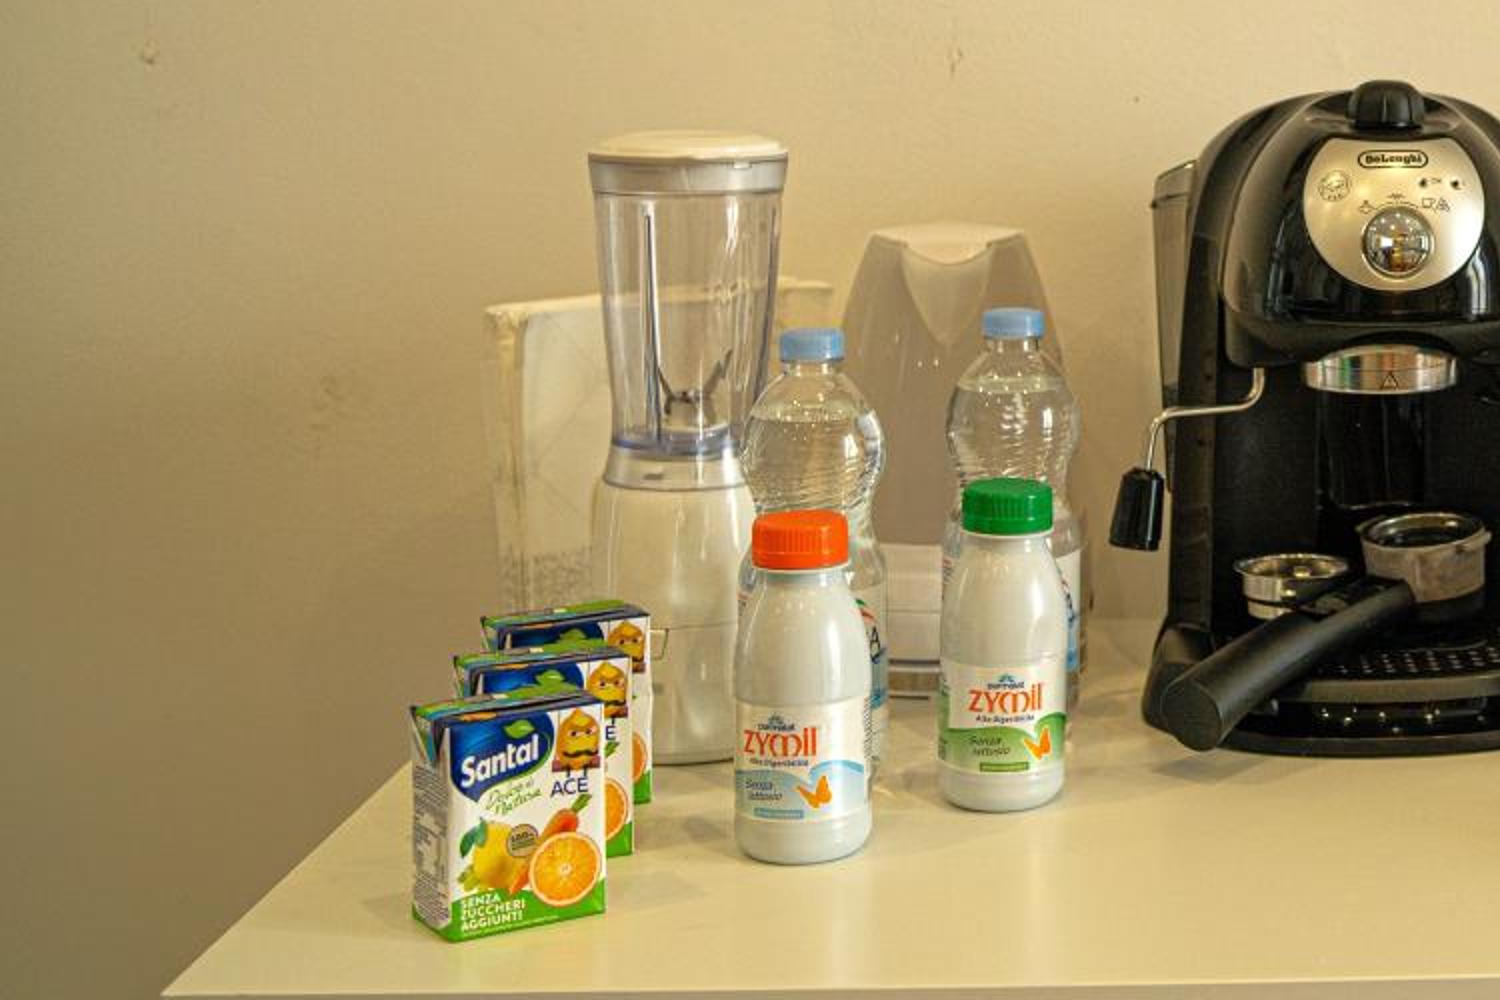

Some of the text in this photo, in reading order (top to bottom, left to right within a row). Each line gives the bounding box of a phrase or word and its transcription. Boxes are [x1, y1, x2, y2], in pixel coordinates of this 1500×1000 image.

[461, 733, 539, 788] Santal
[550, 777, 589, 797] ACE
[462, 893, 501, 909] SENZA
[462, 899, 526, 920] ZUCCHERI
[461, 910, 523, 931] AGGIUNTI
